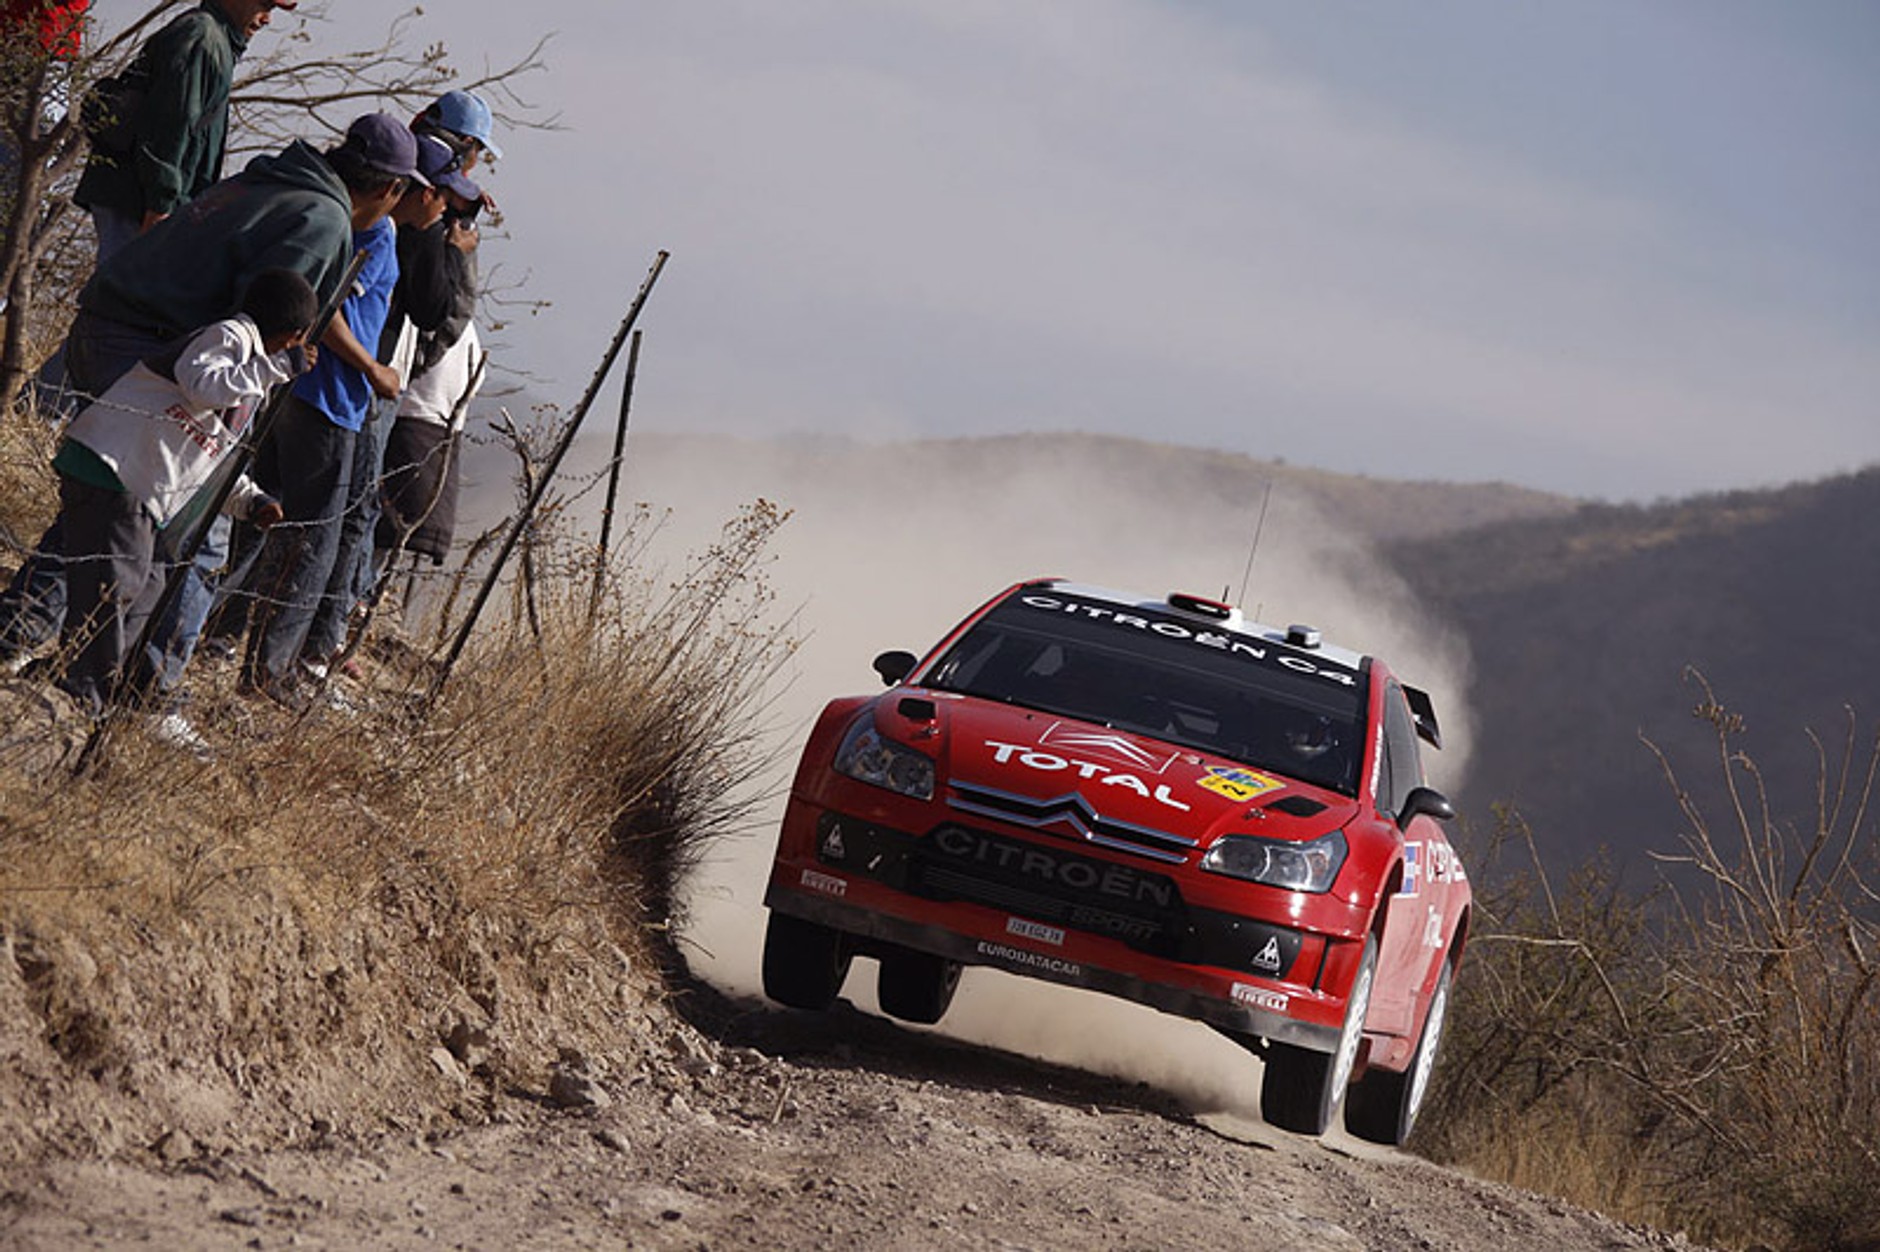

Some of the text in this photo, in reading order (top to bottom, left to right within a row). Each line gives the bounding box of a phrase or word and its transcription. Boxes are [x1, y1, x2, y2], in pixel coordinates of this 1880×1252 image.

[1022, 595, 1356, 687] CITROËN C4
[985, 740, 1191, 812] TOTAL
[935, 828, 1172, 907] CITROËN
[977, 941, 1081, 977] EURODATACAR
